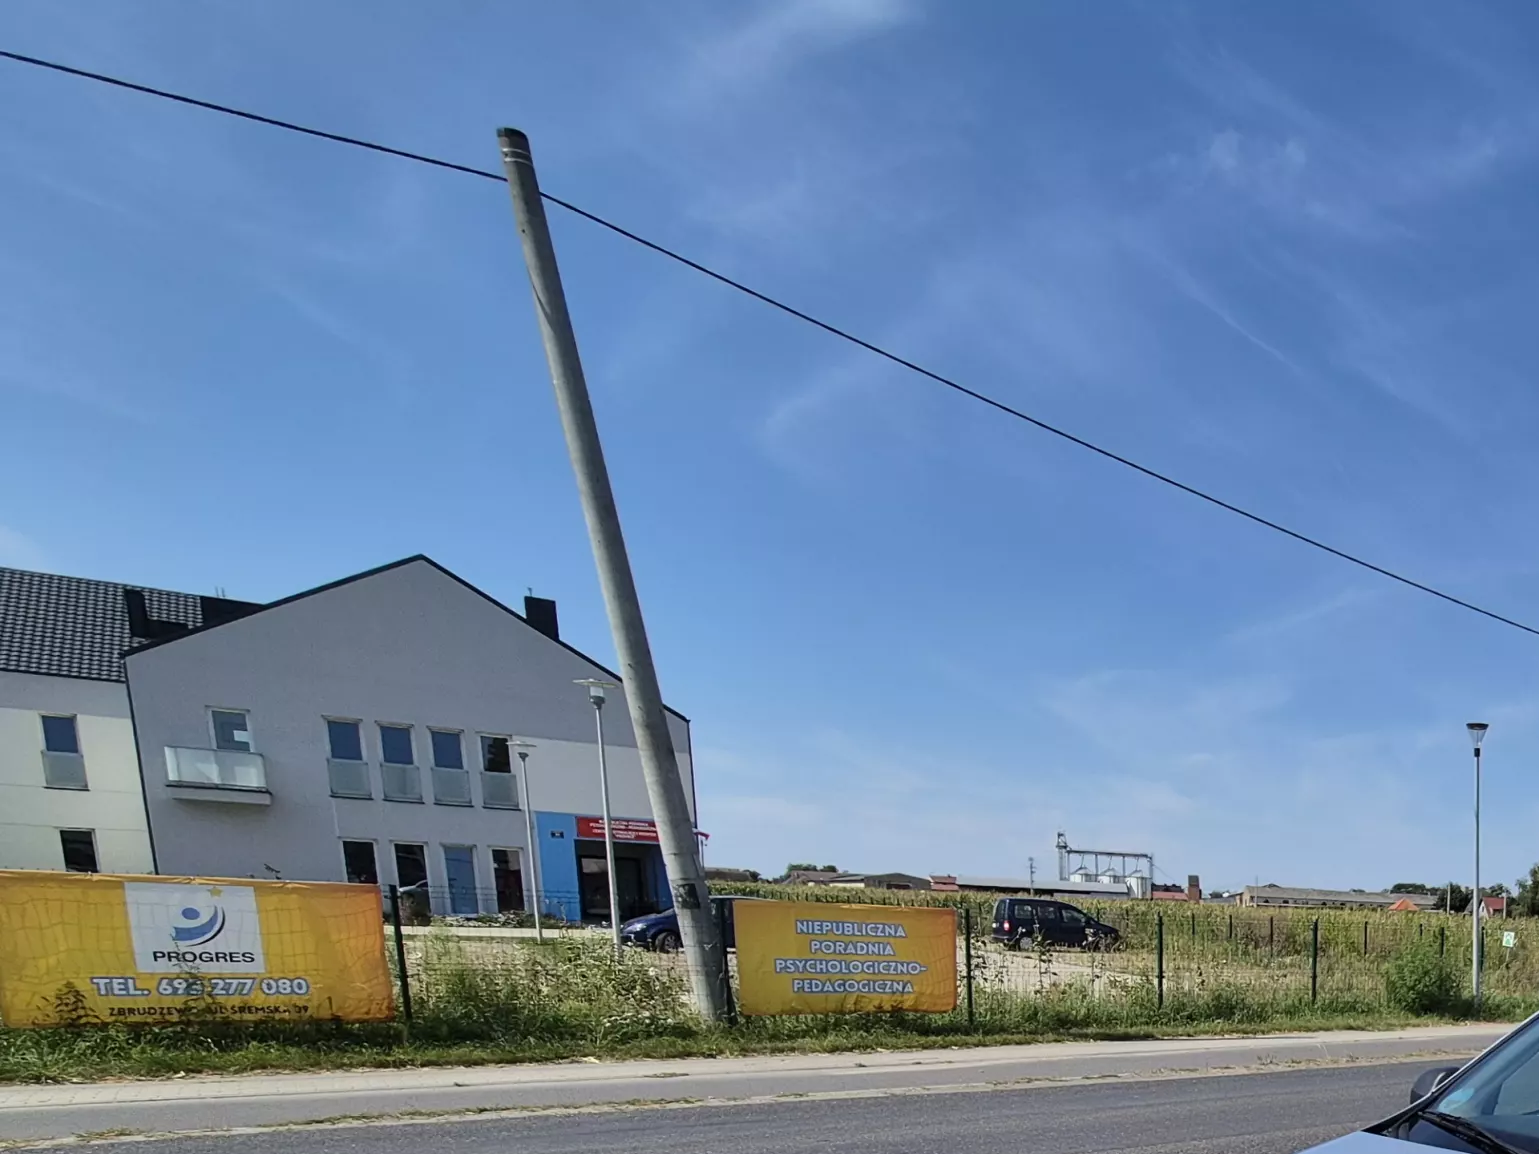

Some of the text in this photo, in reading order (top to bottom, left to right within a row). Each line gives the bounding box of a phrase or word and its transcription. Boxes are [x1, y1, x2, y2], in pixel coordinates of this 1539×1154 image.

[796, 920, 907, 938] NIEPUBLICZNA
[810, 940, 896, 956] PORADNIA
[153, 951, 255, 963] PROGRES
[775, 959, 928, 975] PSYCHOLOGICZNO-
[91, 977, 309, 996] TEL. 693 277 080
[793, 979, 914, 993] PEDAGOGICZNA
